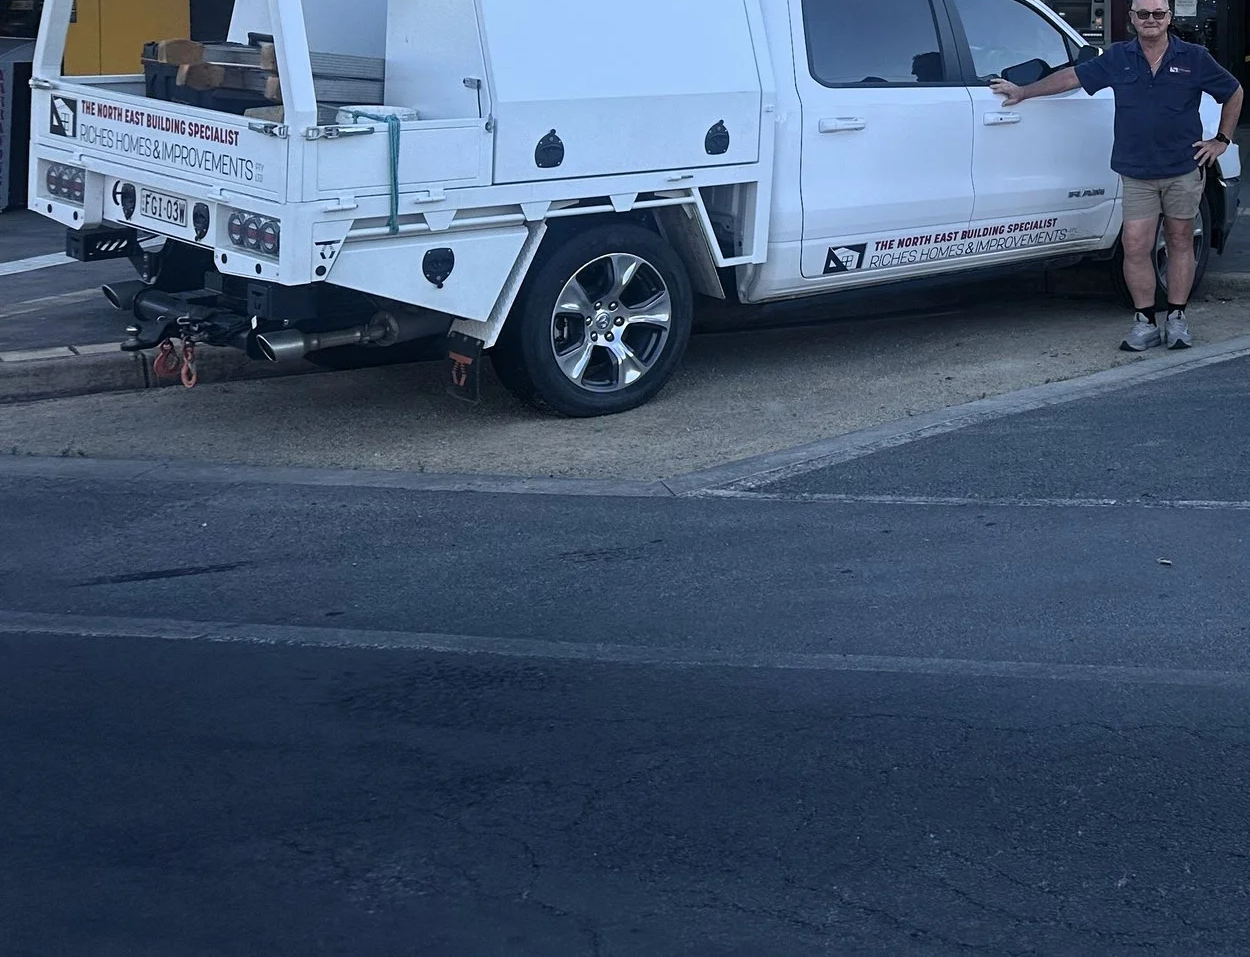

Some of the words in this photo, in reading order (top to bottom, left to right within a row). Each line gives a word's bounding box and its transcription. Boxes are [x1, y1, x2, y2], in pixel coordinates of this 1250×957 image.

[81, 100, 96, 116] THE
[97, 103, 123, 123] NORTH
[124, 109, 144, 126] EAST
[146, 113, 186, 136] BUILDING
[188, 122, 240, 147] SPECIALIST
[80, 123, 114, 148] RICHES
[116, 133, 151, 158] HOMES
[162, 141, 254, 181] IMPROVEMENTS
[869, 250, 917, 269] RICHES
[919, 243, 964, 261] HOMES
[974, 228, 1068, 254] IMPROVEMENTS
[874, 240, 895, 252] THE
[897, 235, 932, 249] NORTH
[934, 230, 960, 244] EAST
[961, 224, 1005, 240] BUILDING
[1007, 218, 1058, 233] SPECIALIST
